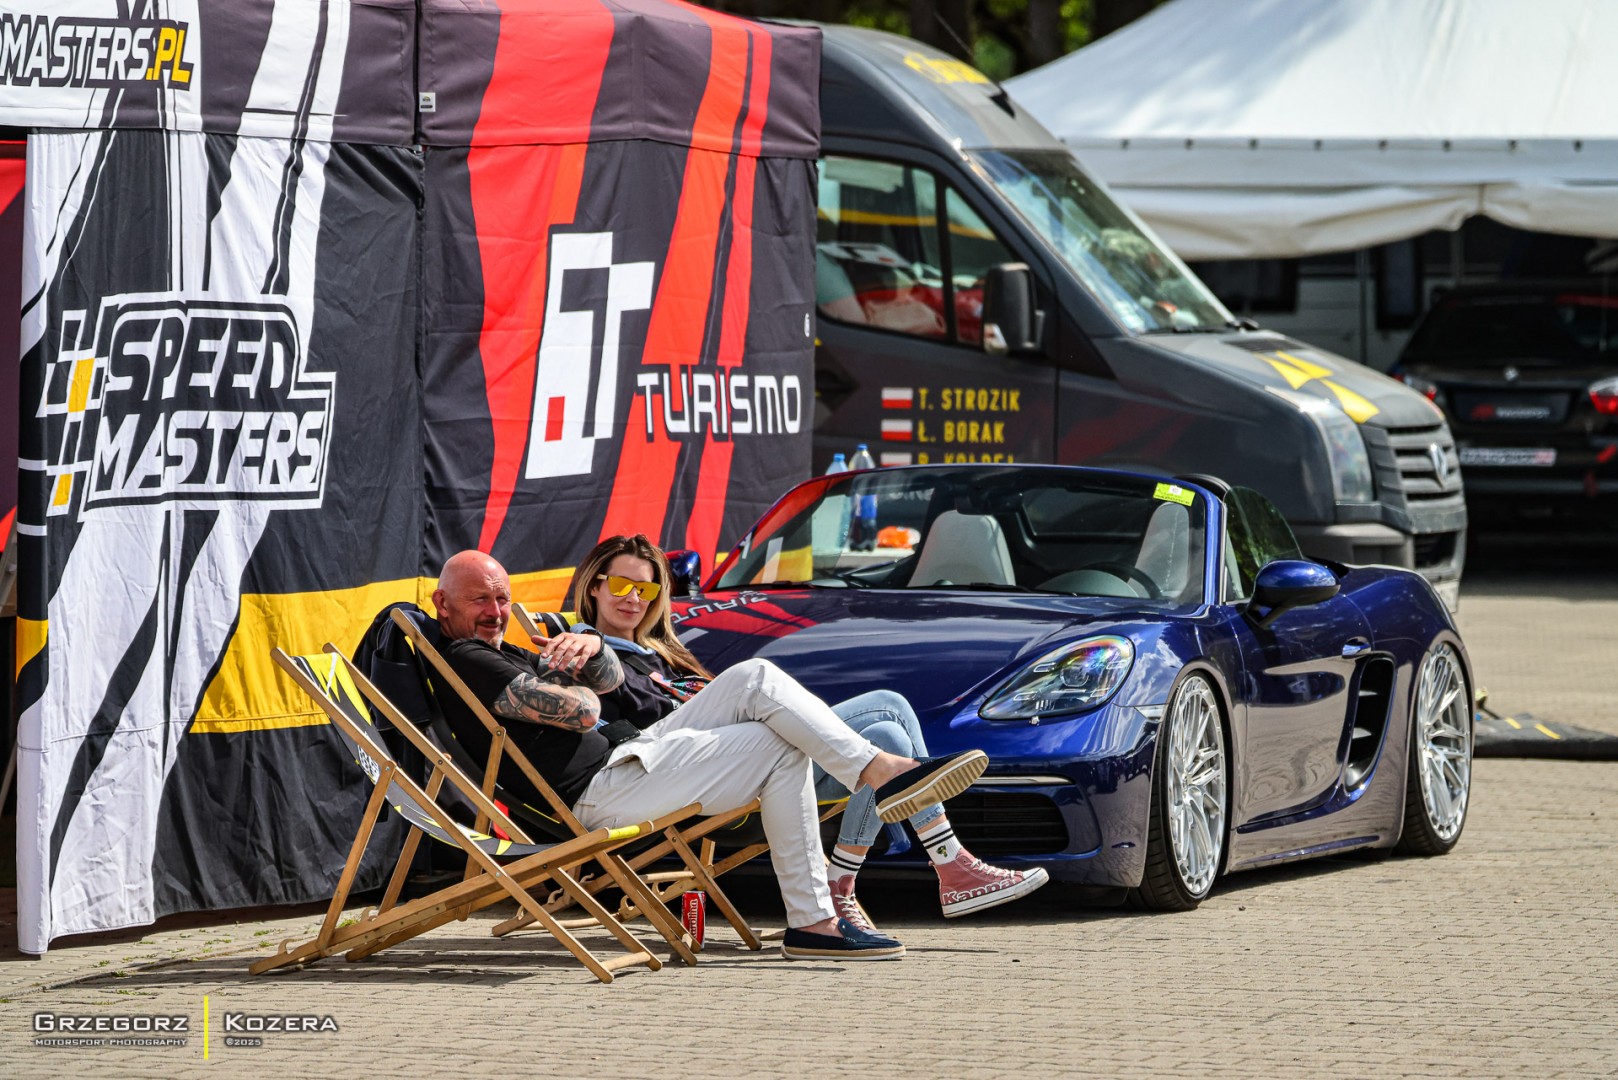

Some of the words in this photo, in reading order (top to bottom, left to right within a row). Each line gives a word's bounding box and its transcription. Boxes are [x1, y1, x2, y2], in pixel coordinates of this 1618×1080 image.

[0, 21, 191, 84] MASTERS.PL
[108, 317, 296, 401] SPEED
[637, 371, 801, 435] TURISMO
[918, 387, 934, 411] T.
[941, 387, 1020, 412] STROZIK
[95, 409, 325, 492] MASTERS
[943, 420, 1005, 443] BORAK
